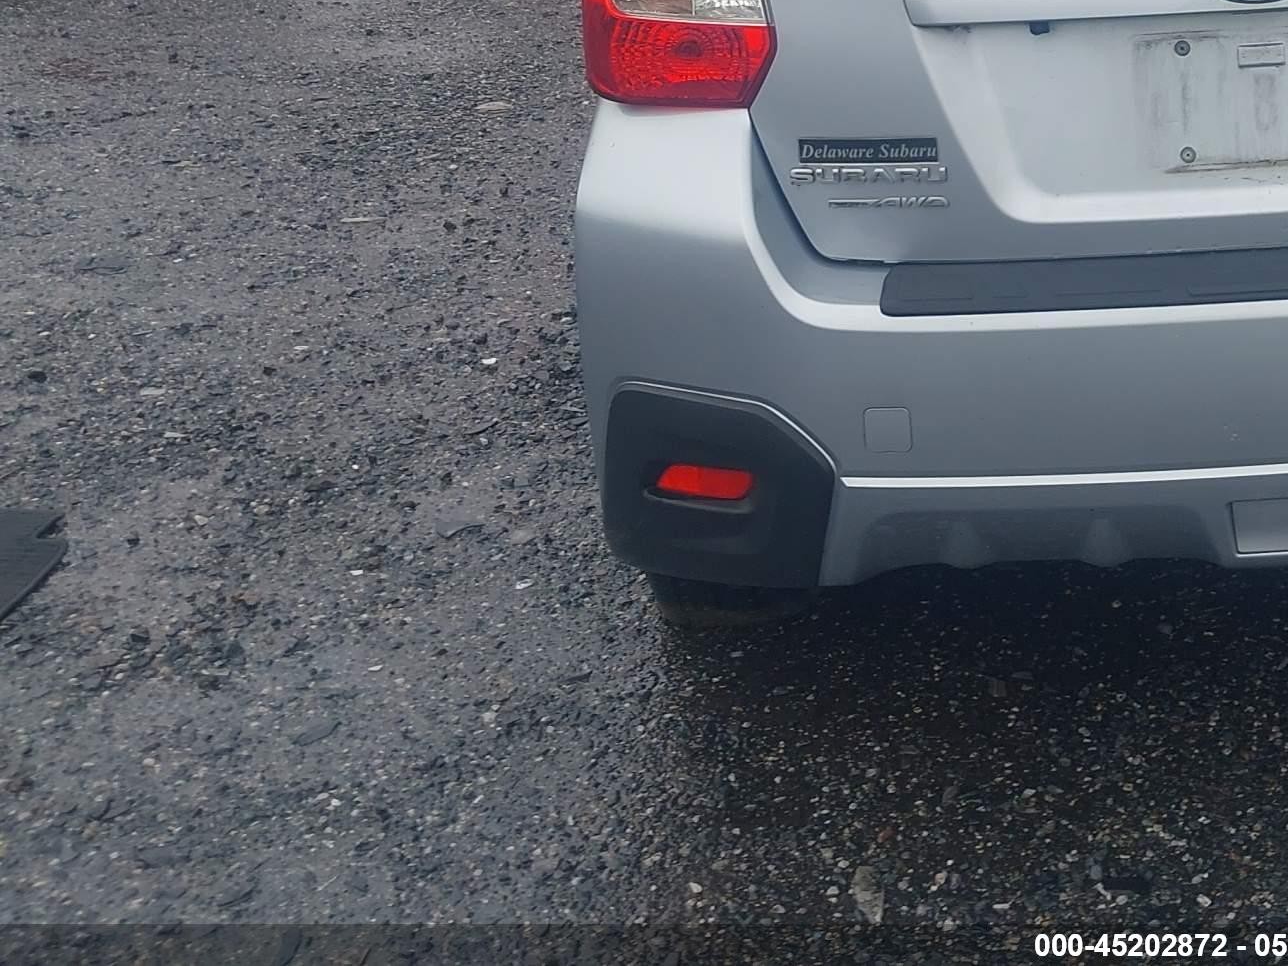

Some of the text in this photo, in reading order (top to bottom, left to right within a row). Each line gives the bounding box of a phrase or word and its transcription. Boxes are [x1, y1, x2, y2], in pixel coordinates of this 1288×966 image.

[801, 140, 937, 159] Delaware Subaru
[789, 166, 948, 185] SUBARU
